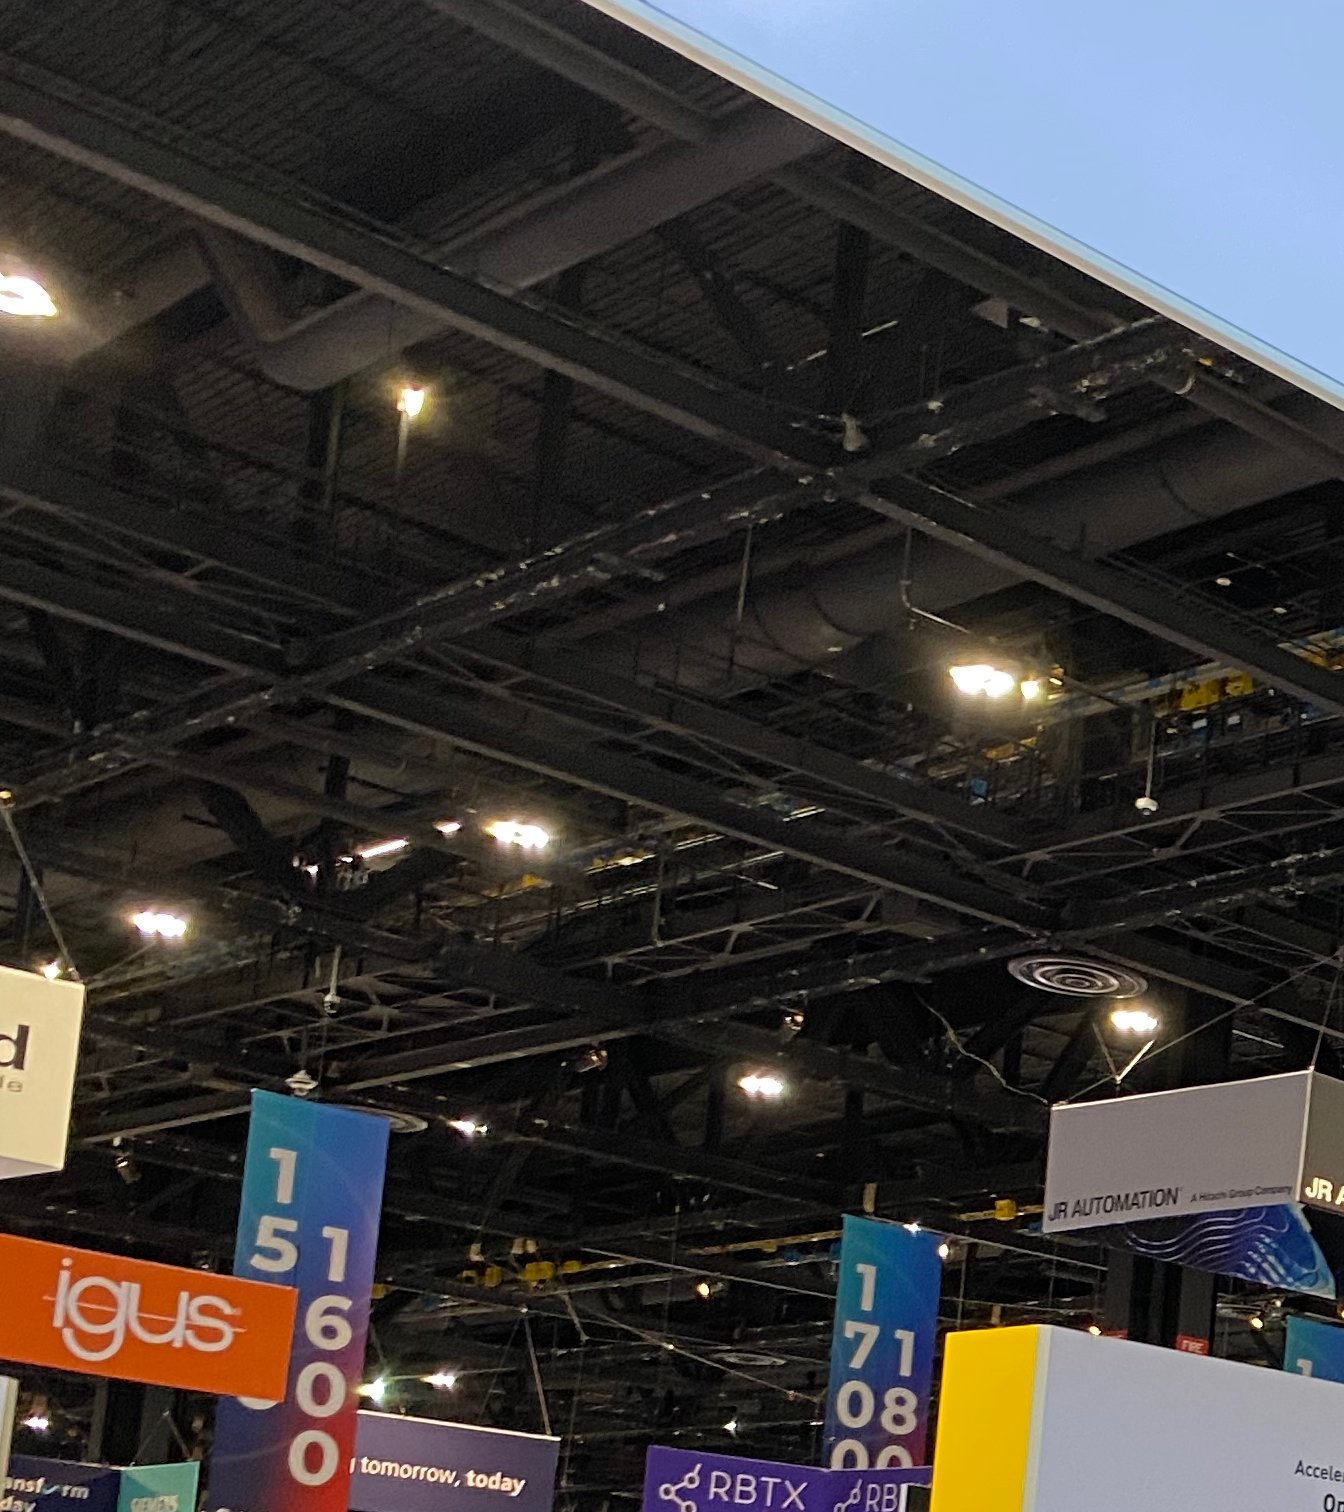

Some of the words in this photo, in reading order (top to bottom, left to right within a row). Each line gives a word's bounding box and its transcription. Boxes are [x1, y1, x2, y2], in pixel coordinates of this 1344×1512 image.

[1305, 1177, 1333, 1202] JR
[1049, 1202, 1067, 1222] JR
[53, 1258, 238, 1362] igus
[360, 1456, 461, 1488] tomorrow,
[465, 1469, 526, 1497] today
[709, 1471, 808, 1511] RBTX
